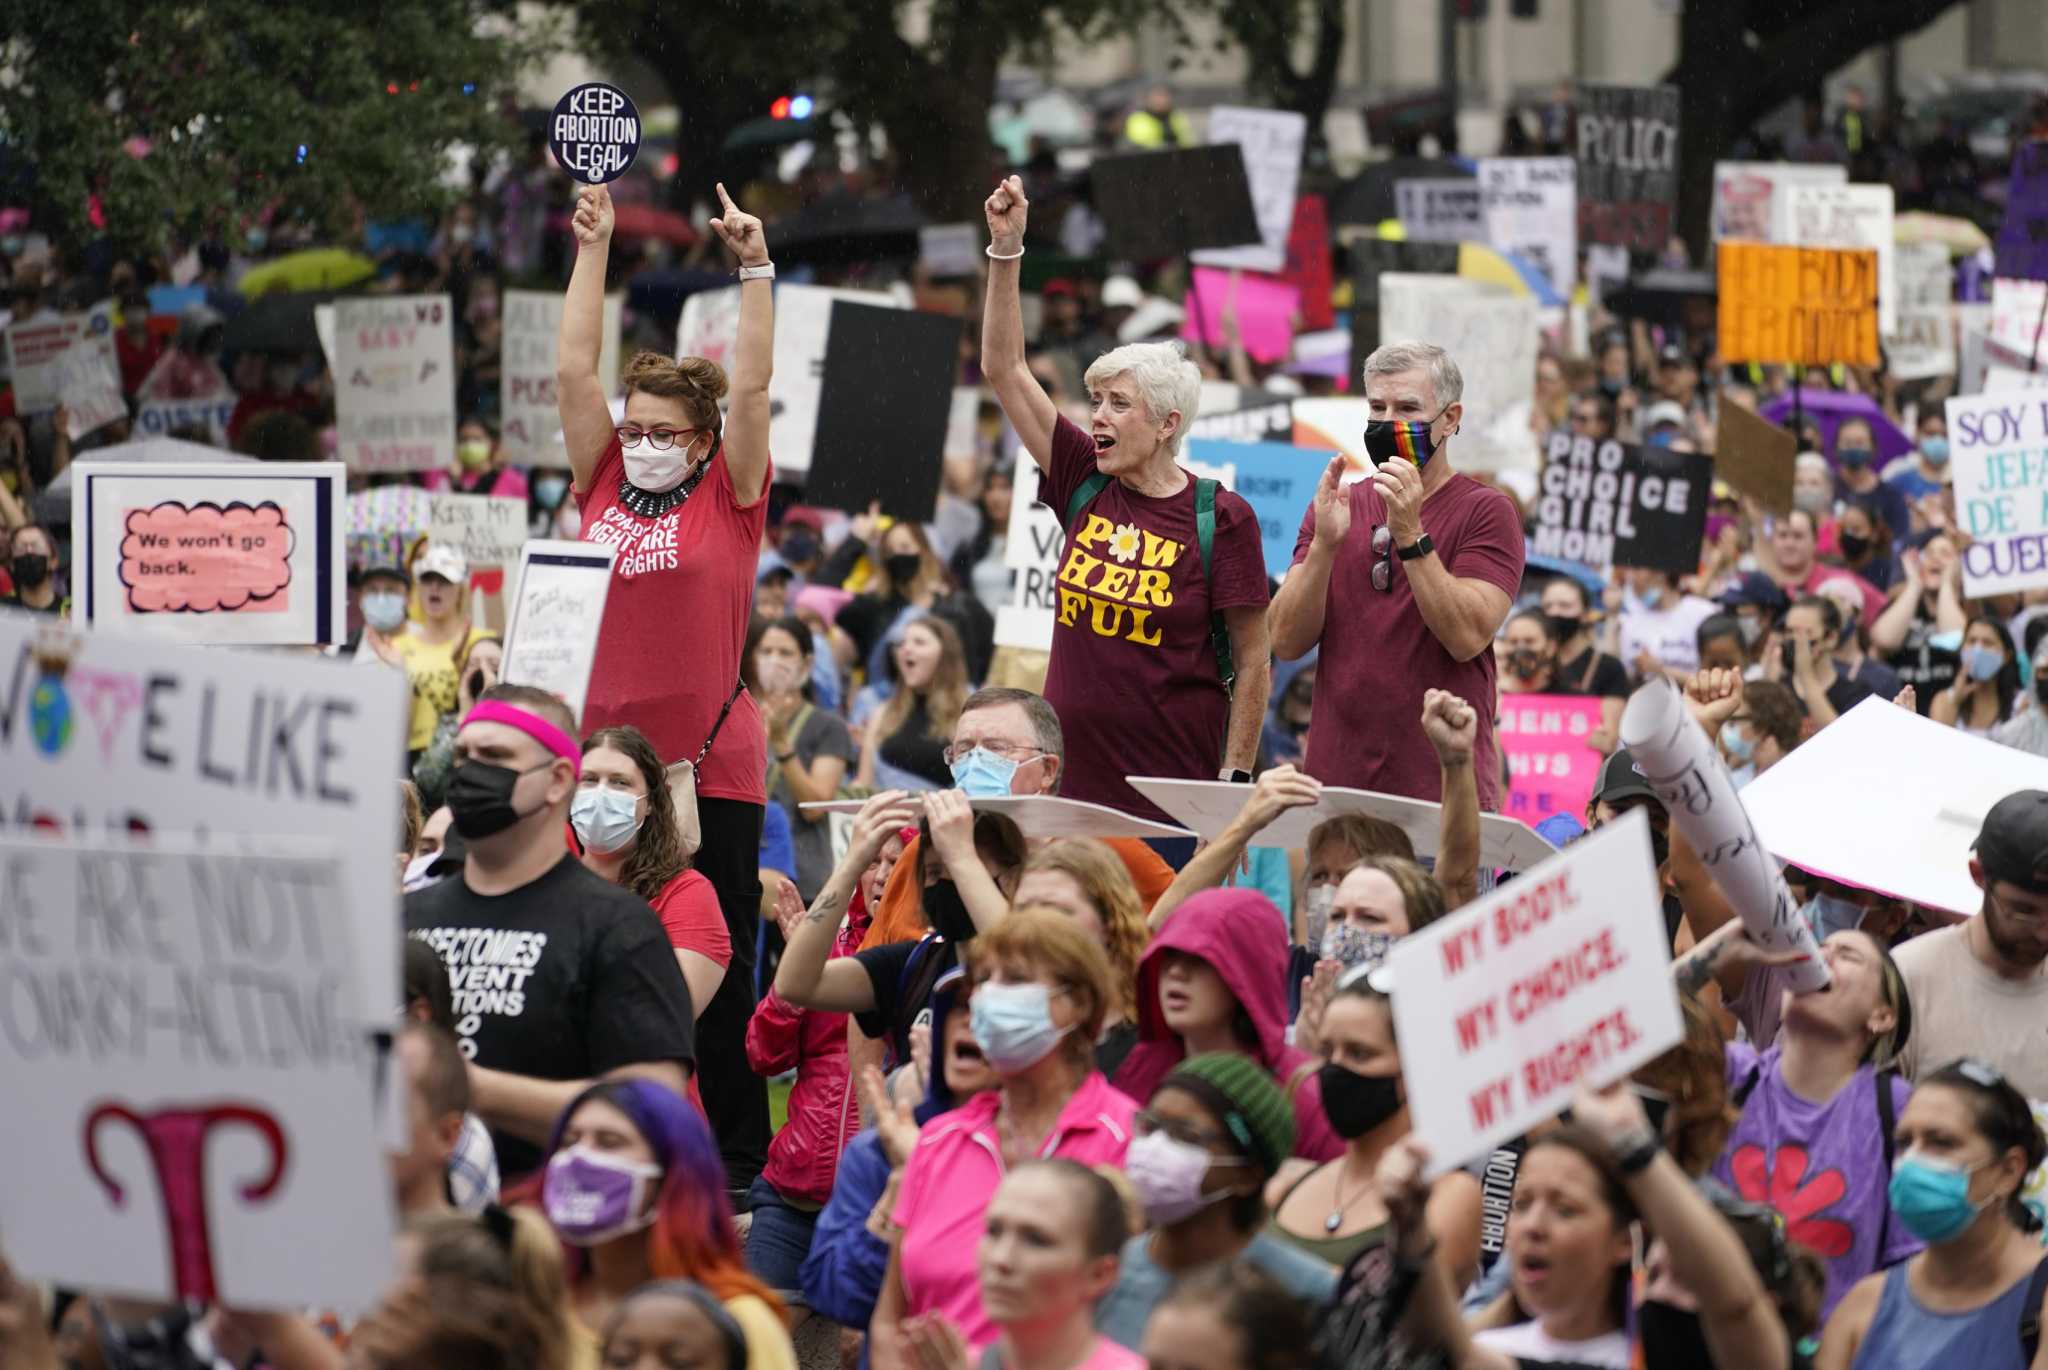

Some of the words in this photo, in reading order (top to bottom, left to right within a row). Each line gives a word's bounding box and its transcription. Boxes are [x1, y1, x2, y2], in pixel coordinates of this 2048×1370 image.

[570, 88, 624, 115] KEEP
[555, 114, 637, 144] ABORTION
[562, 143, 628, 171] LEGAL
[1958, 407, 2027, 447] SOY
[1548, 431, 1624, 472] PRO
[1542, 462, 1689, 516] CHOICE
[1539, 495, 1636, 539] GIRL
[1967, 496, 2017, 539] DE
[139, 534, 170, 549] We
[178, 533, 234, 549] won't
[241, 535, 266, 552] go
[619, 549, 678, 576] RIGHTS
[1533, 524, 1616, 565] MOM
[140, 562, 196, 577] back.
[1058, 546, 1174, 608] HER
[1057, 586, 1163, 648] FUL
[195, 680, 358, 807] LIKE
[1441, 918, 1484, 978] MY
[1456, 996, 1497, 1055] MY
[1469, 1074, 1514, 1132] MY
